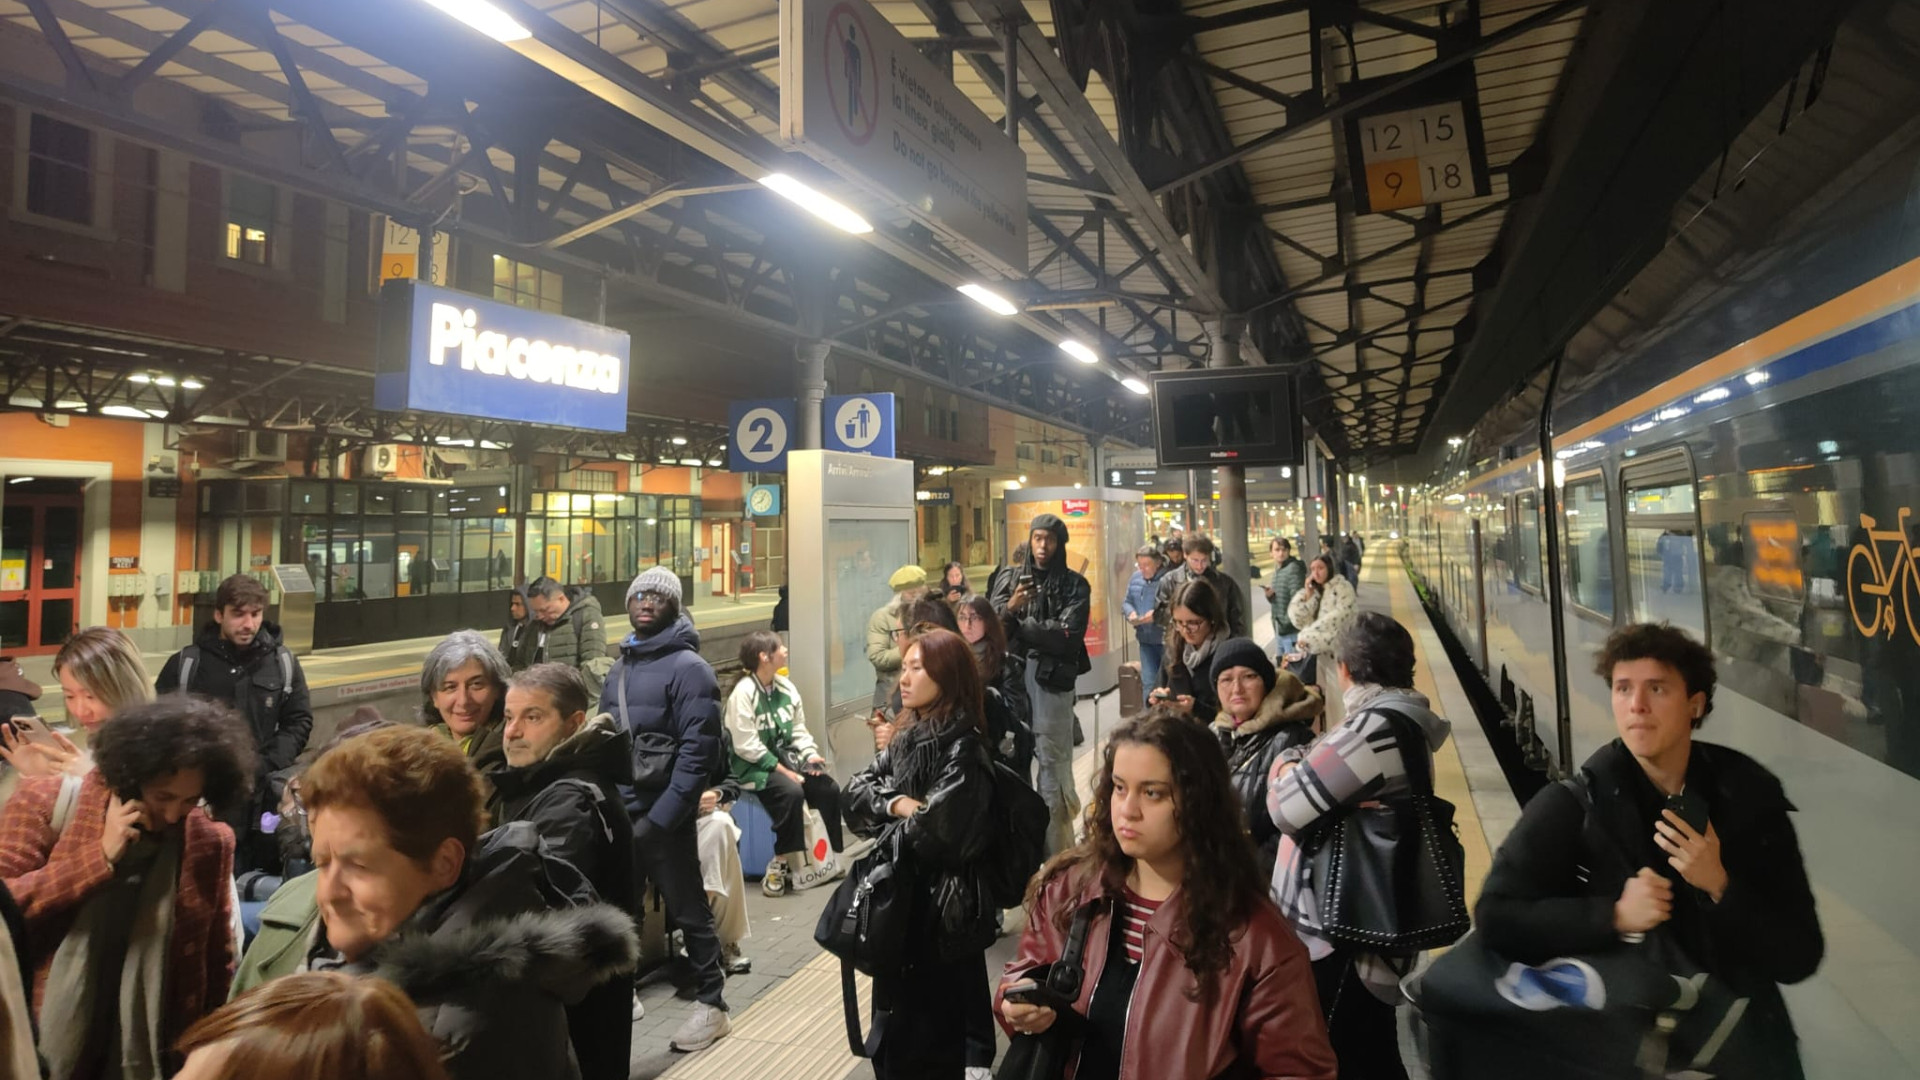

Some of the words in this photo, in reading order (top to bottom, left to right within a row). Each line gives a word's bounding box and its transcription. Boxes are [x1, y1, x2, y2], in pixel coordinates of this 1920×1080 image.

[892, 83, 902, 112] la
[904, 94, 928, 131] linea
[931, 119, 956, 153] gialla
[898, 66, 932, 107] vietato
[934, 96, 982, 152] oltrepassare
[893, 130, 907, 157] Do
[909, 145, 925, 171] not
[1368, 124, 1402, 153] 12
[1419, 114, 1454, 144] 15
[1384, 171, 1403, 199] 9
[1427, 163, 1462, 192] 18
[391, 224, 410, 245] 12
[429, 302, 621, 395] Piacenza
[749, 416, 774, 454] 2
